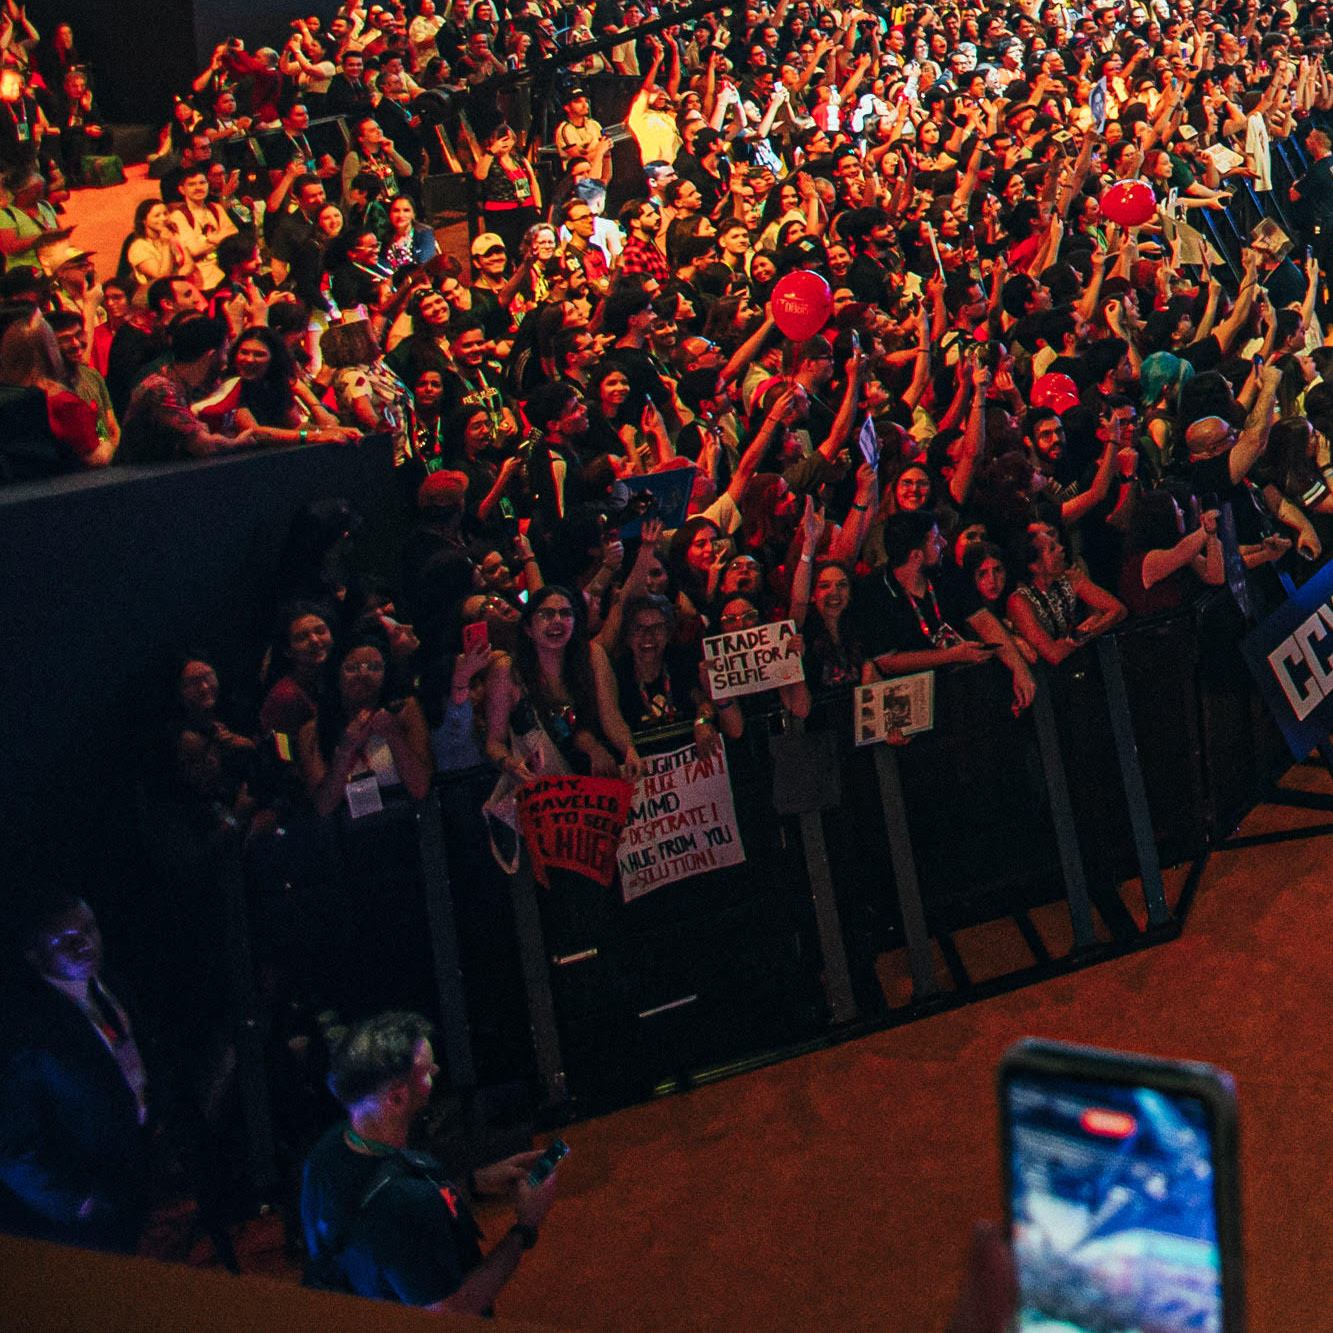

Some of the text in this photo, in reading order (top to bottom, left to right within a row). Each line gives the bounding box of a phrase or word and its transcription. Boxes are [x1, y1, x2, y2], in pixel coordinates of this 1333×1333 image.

[705, 622, 794, 657] TRADE A
[711, 653, 750, 673] GIFT
[754, 647, 783, 666] FOR
[713, 665, 770, 691] SELFIE
[644, 771, 678, 798] HUGE
[529, 794, 619, 814] RAVELED
[658, 832, 697, 860] FROM
[704, 824, 733, 848] YOU
